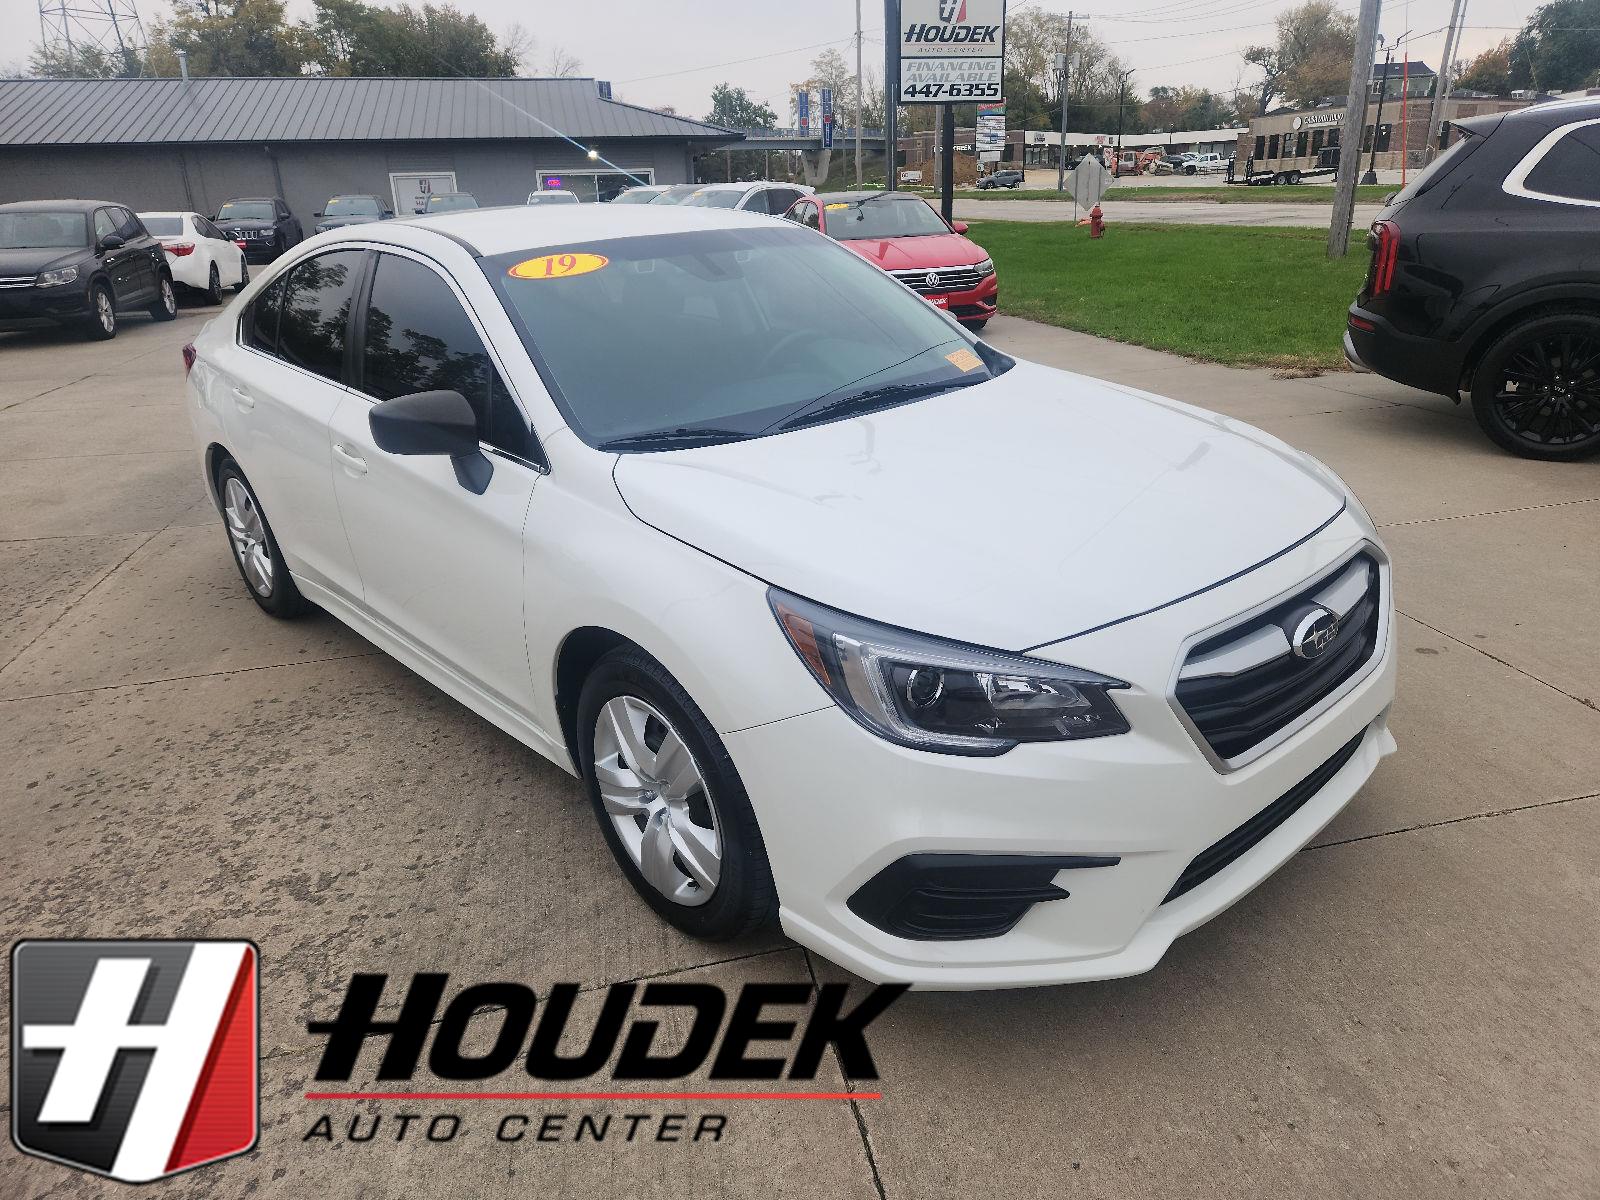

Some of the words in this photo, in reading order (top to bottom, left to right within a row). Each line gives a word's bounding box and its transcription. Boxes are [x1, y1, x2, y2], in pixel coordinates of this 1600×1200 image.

[904, 24, 1000, 43] HOUDEK
[906, 61, 997, 72] FINANCING
[905, 72, 998, 83] AVAILABLE
[903, 83, 1000, 98] 447-6355
[543, 255, 577, 276] 19
